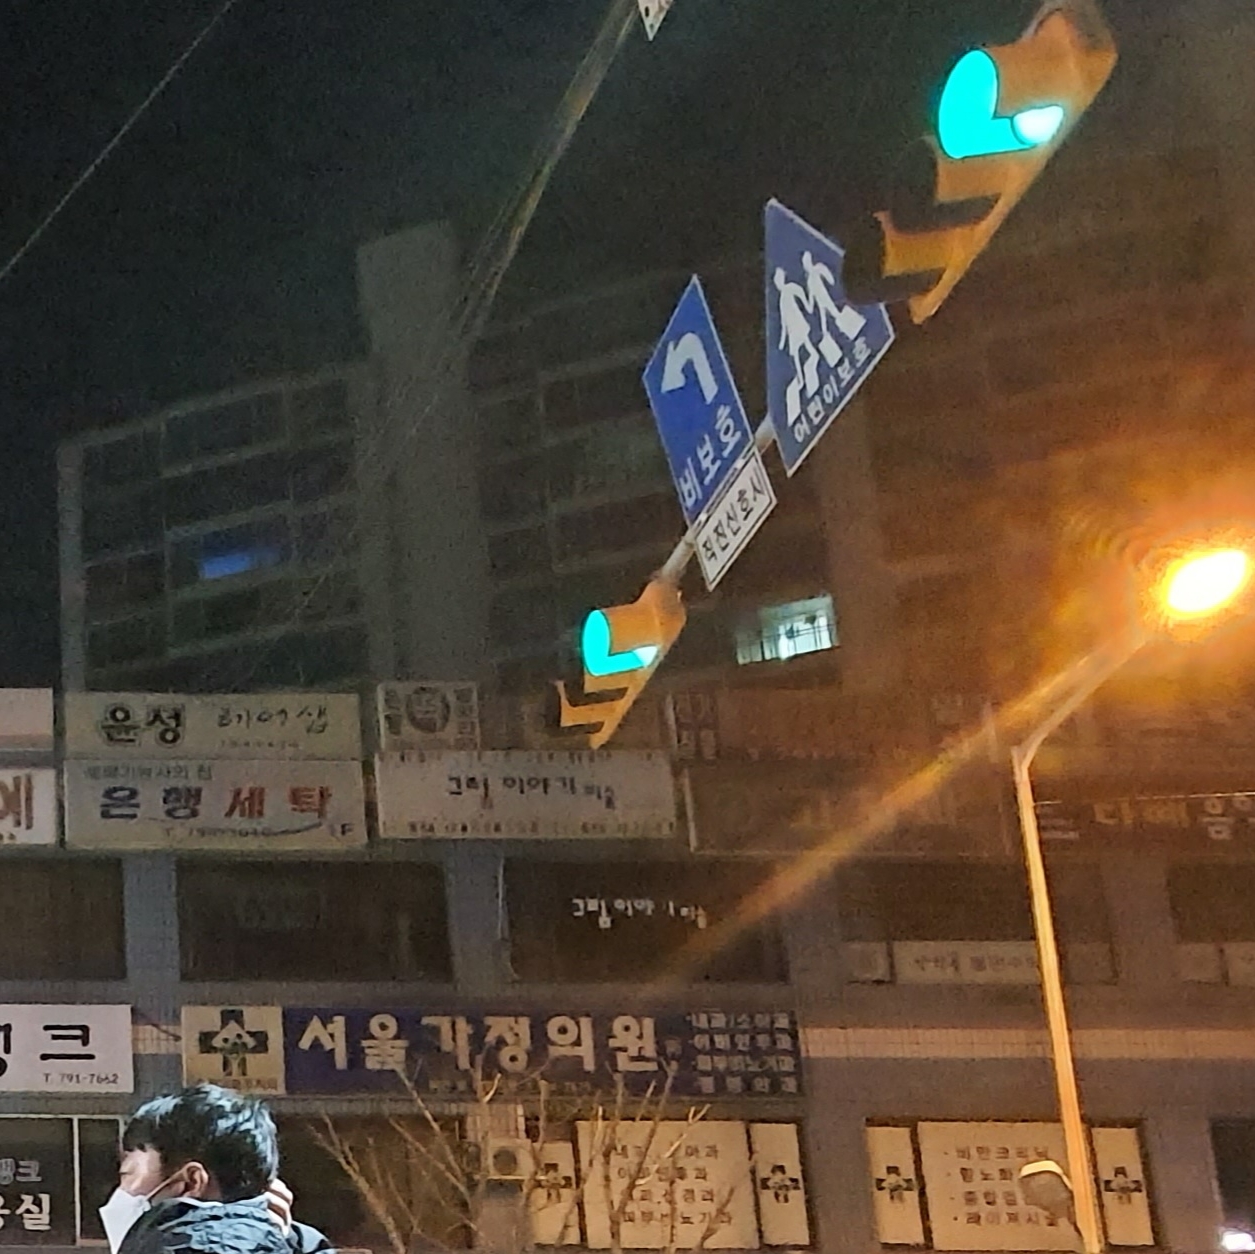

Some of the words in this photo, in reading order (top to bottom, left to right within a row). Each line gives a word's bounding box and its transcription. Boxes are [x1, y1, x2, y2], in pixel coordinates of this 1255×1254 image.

[793, 336, 872, 443] 어린이보호
[678, 405, 742, 510] 비보호
[298, 1013, 659, 1073] 서울가정의원
